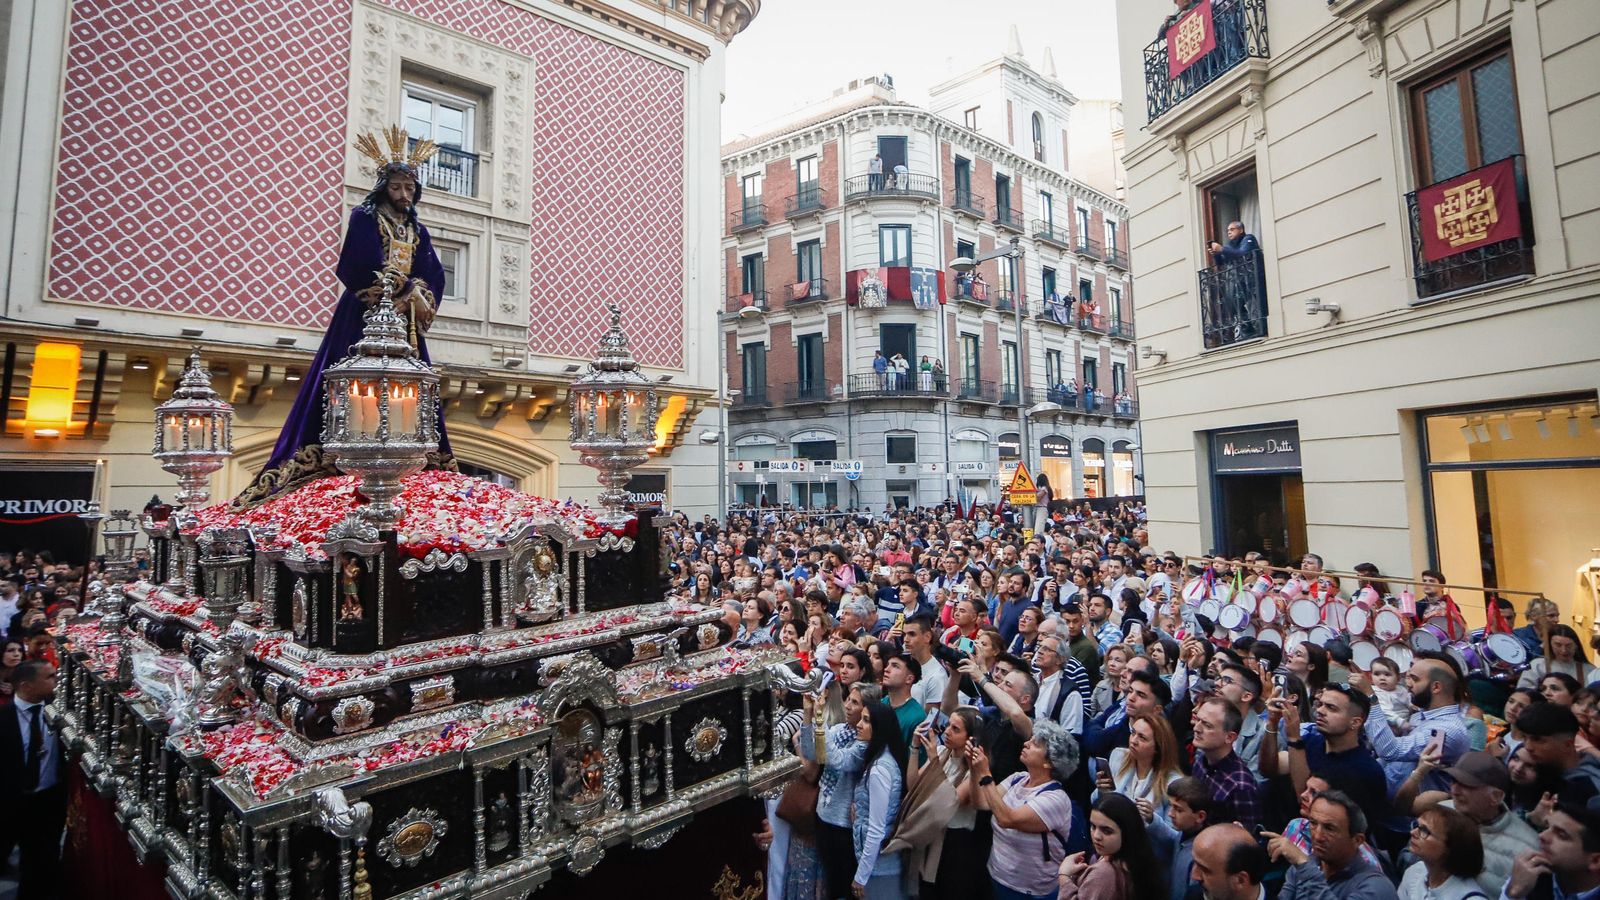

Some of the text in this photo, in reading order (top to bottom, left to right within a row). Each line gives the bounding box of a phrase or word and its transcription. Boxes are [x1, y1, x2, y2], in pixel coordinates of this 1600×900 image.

[1223, 439, 1294, 457] Massimo Dutti
[770, 461, 788, 470] SALIDA
[832, 462, 851, 470] SALIDA
[628, 492, 663, 502] RIMOR
